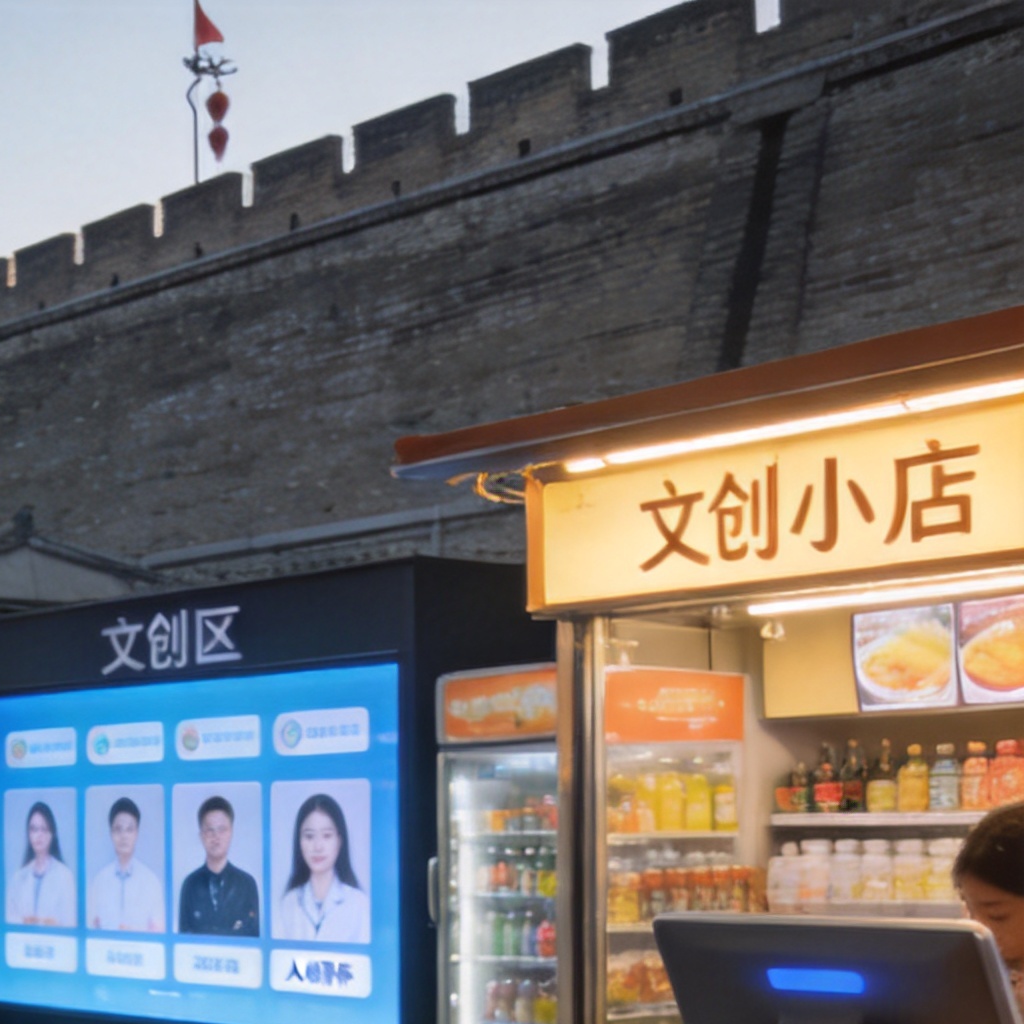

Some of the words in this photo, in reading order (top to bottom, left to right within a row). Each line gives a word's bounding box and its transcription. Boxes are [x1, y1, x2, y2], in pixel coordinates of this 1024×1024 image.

[639, 438, 980, 572] 文创小店
[101, 605, 242, 675] 文创区
